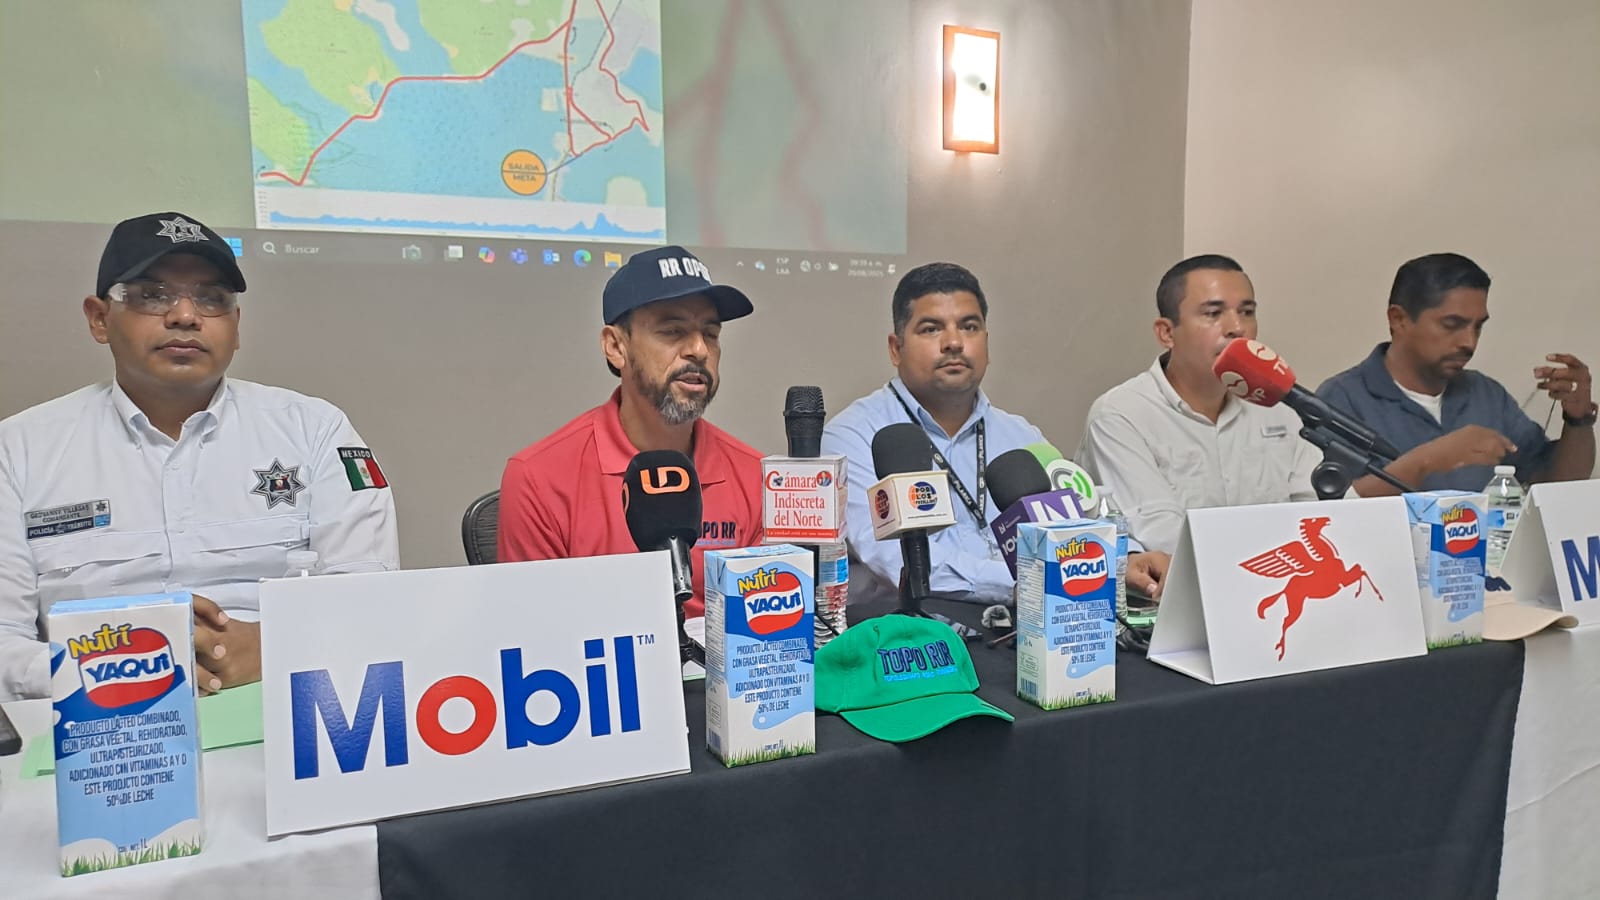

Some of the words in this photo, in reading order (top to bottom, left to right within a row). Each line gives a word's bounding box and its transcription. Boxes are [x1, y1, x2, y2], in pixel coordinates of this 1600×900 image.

[285, 243, 320, 254] Buscar
[658, 257, 683, 279] RR
[340, 448, 371, 458] MEXICO
[766, 470, 818, 491] Cámara
[773, 492, 826, 509] Indiscreta
[773, 510, 790, 527] del
[792, 510, 823, 527] Norte
[721, 521, 736, 539] RR
[1446, 523, 1478, 538] YAQUI
[1055, 537, 1088, 561] Nutri
[1062, 559, 1106, 579] YAQUI
[737, 567, 778, 595] Nutri
[747, 592, 801, 614] YAQUI
[67, 623, 132, 660] Nutri
[732, 658, 743, 668] CON
[877, 646, 928, 675] TOPO
[924, 639, 956, 669] RR
[86, 652, 171, 683] YAQUI
[736, 679, 763, 692] ADICIONADO
[764, 678, 773, 688] CON
[774, 675, 798, 687] VITAMINAS
[745, 693, 756, 703] ESTE
[756, 688, 780, 701] PRODUCTO
[780, 686, 802, 698] CONTIENE
[289, 635, 641, 781] Mobil
[637, 634, 655, 646] TM
[769, 701, 776, 712] DE
[776, 700, 789, 711] LECHE
[69, 719, 110, 737] PRODUCTO
[110, 714, 137, 730] LÁCTEO
[63, 740, 79, 753] CON
[80, 734, 105, 751] GRASA
[69, 766, 114, 782] ADICIONADO
[115, 763, 129, 775] CON
[129, 756, 169, 773] VITAMINAS
[169, 754, 175, 766] A
[175, 754, 181, 766] Y
[181, 753, 187, 765] D
[84, 781, 102, 795] ESTE
[102, 775, 140, 793] PRODUCTO
[140, 770, 175, 786] CONTIENE
[132, 788, 155, 803] LECHE
